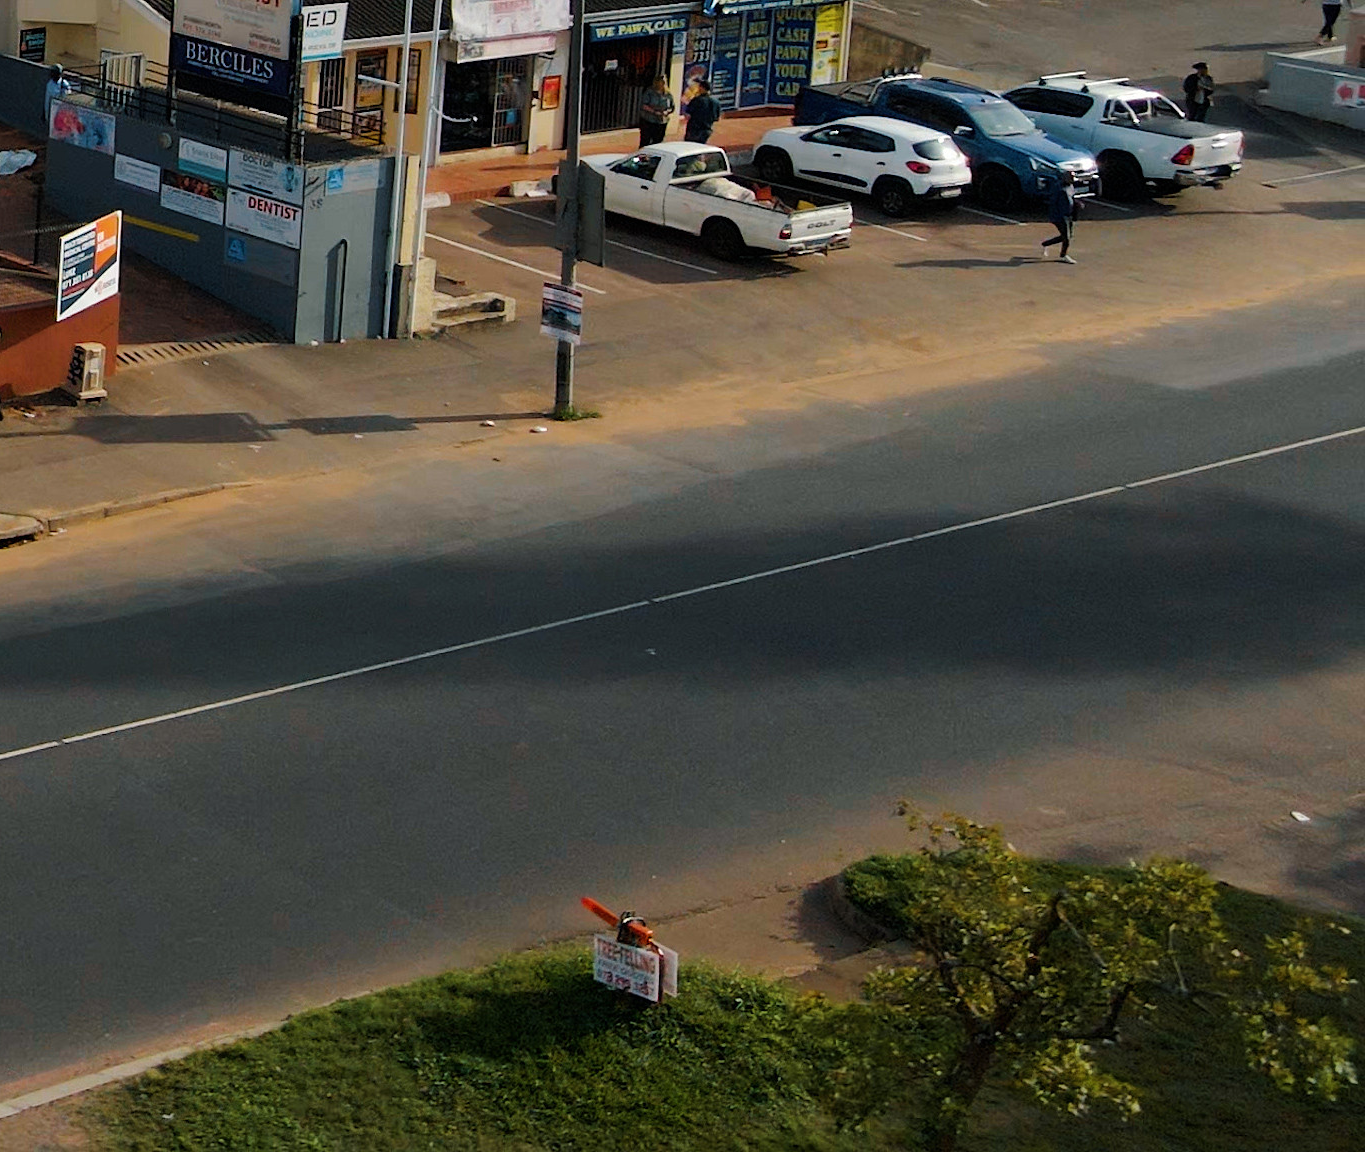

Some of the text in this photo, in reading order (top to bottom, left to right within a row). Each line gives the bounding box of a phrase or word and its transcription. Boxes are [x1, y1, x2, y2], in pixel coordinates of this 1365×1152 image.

[306, 10, 337, 28] ED
[776, 7, 815, 22] QUICK
[594, 17, 687, 39] WE PAWN CARS
[776, 27, 811, 42] CASH
[186, 40, 274, 79] BERCILES
[745, 52, 767, 67] CARS
[775, 45, 810, 60] PAWN
[774, 64, 807, 78] YOUR
[248, 196, 299, 221] DENTIST
[807, 219, 836, 229] COLT
